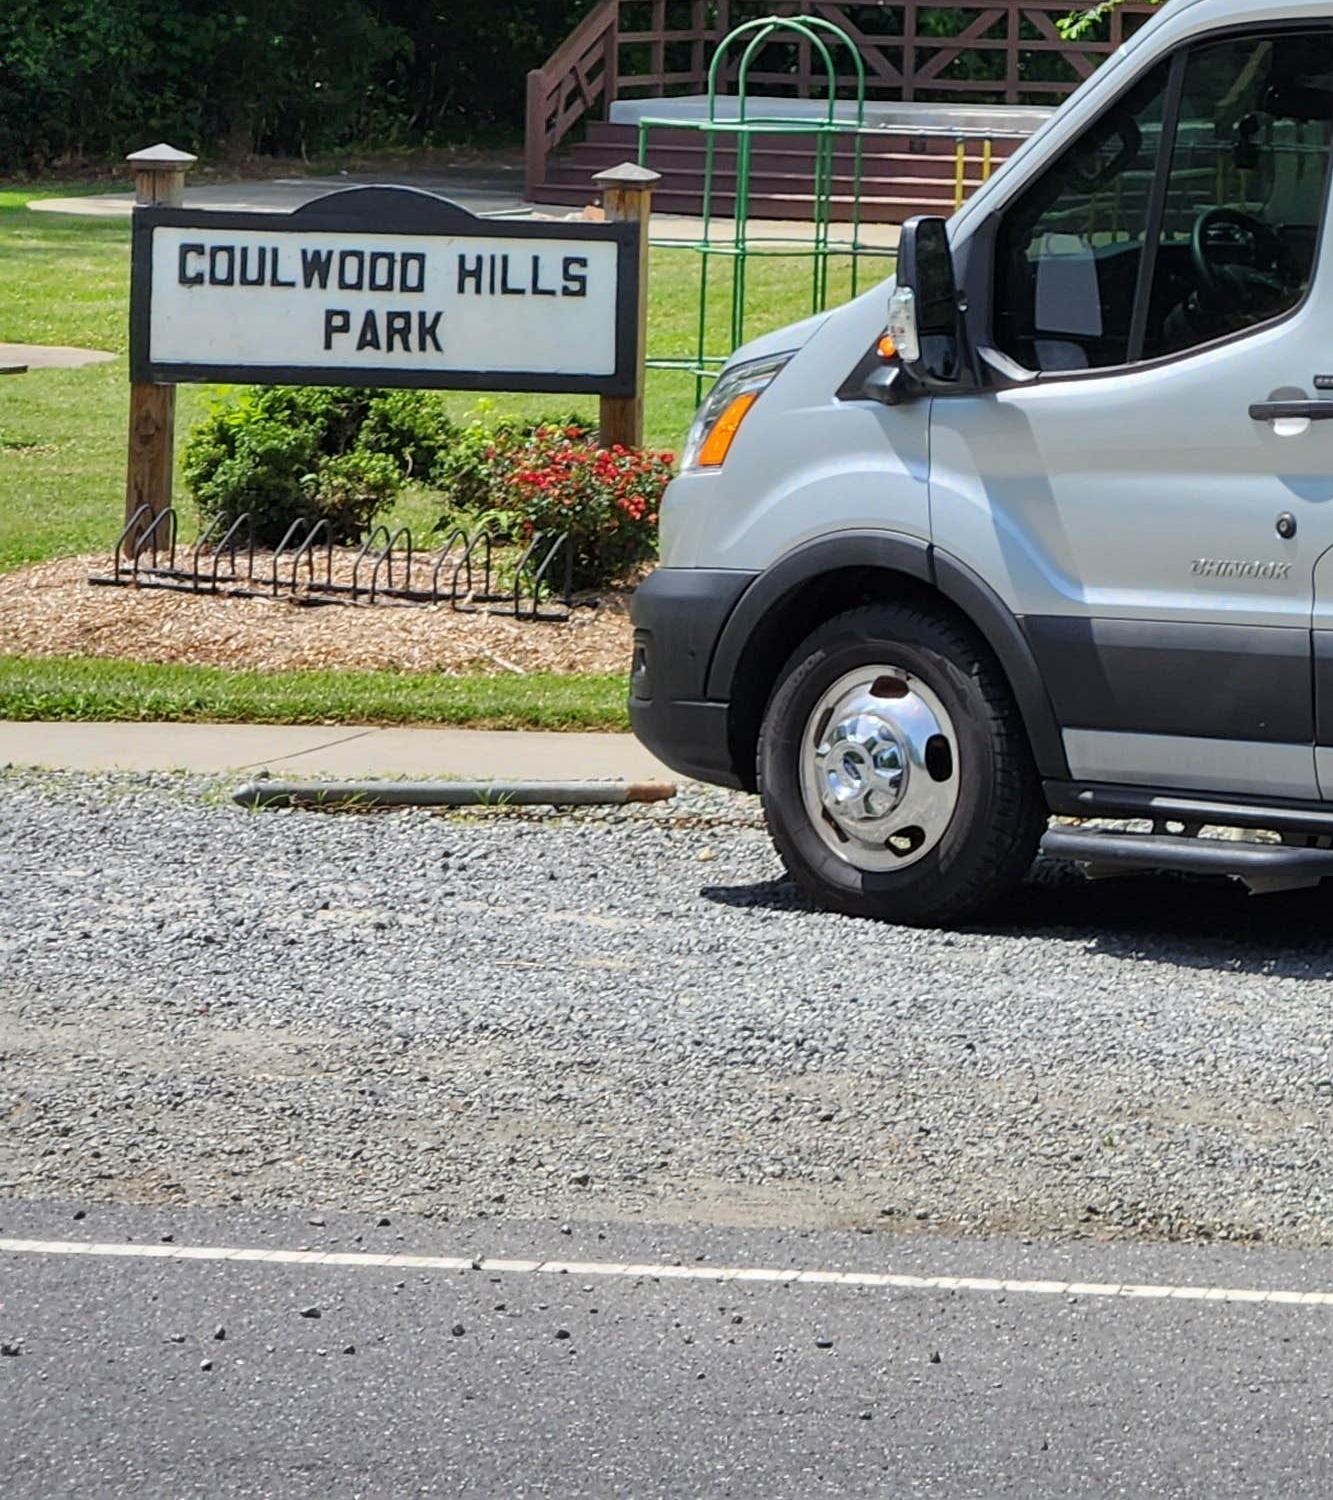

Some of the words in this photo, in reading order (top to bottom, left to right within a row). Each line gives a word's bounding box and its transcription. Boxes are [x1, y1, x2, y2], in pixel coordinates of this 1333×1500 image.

[178, 243, 426, 293] COULWOOD
[457, 253, 589, 297] HILLS
[324, 309, 444, 353] PARK
[1190, 557, 1292, 580] CHINOOK
